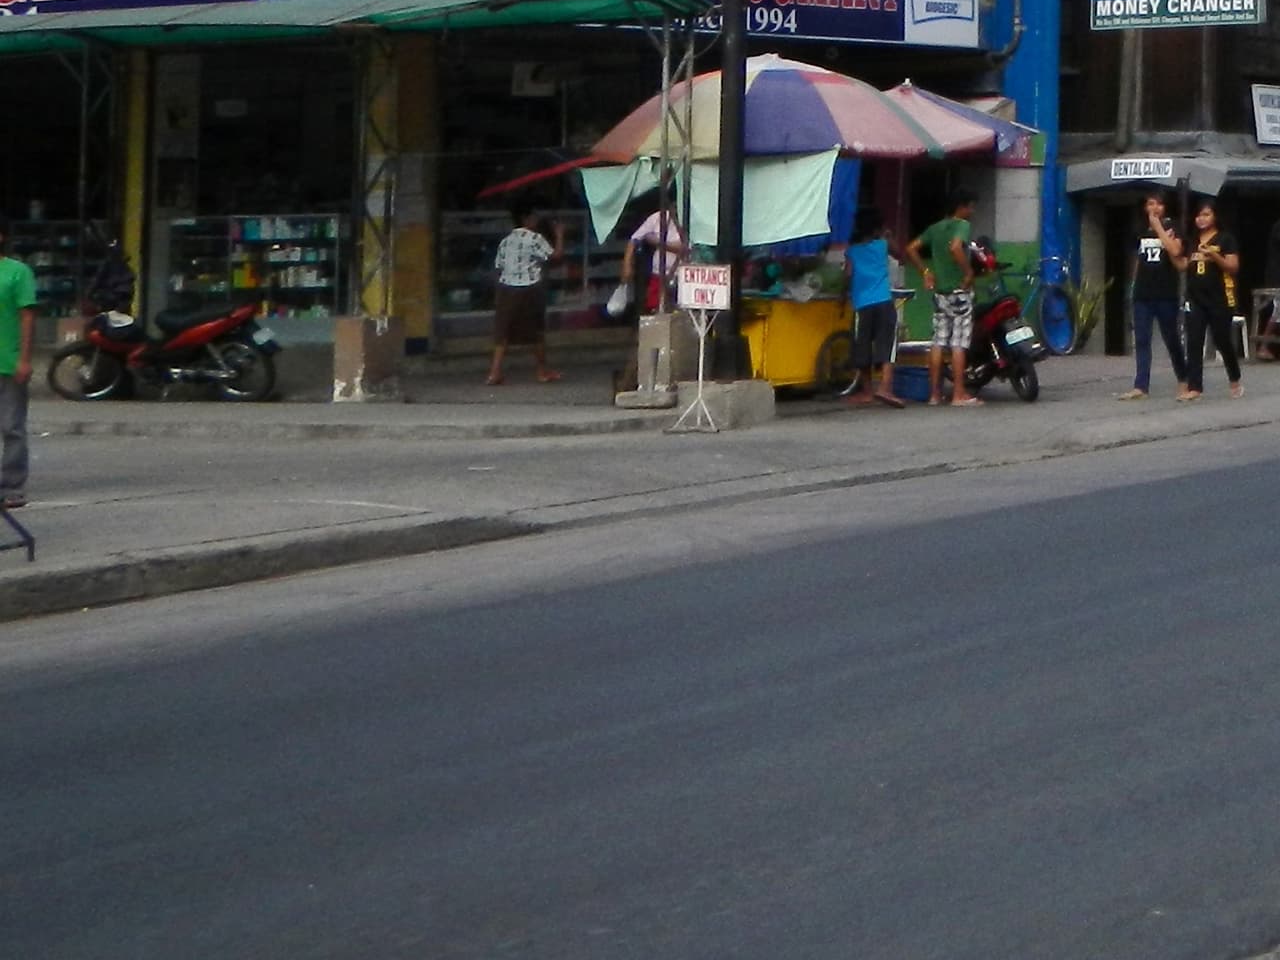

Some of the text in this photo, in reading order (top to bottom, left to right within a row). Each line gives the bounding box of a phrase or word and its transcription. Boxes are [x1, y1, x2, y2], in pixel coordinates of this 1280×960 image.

[746, 6, 798, 33] 1994
[1114, 161, 1171, 176] DENTAL CLINIC
[684, 267, 728, 286] ENTRANCE
[694, 288, 716, 305] ONLY
